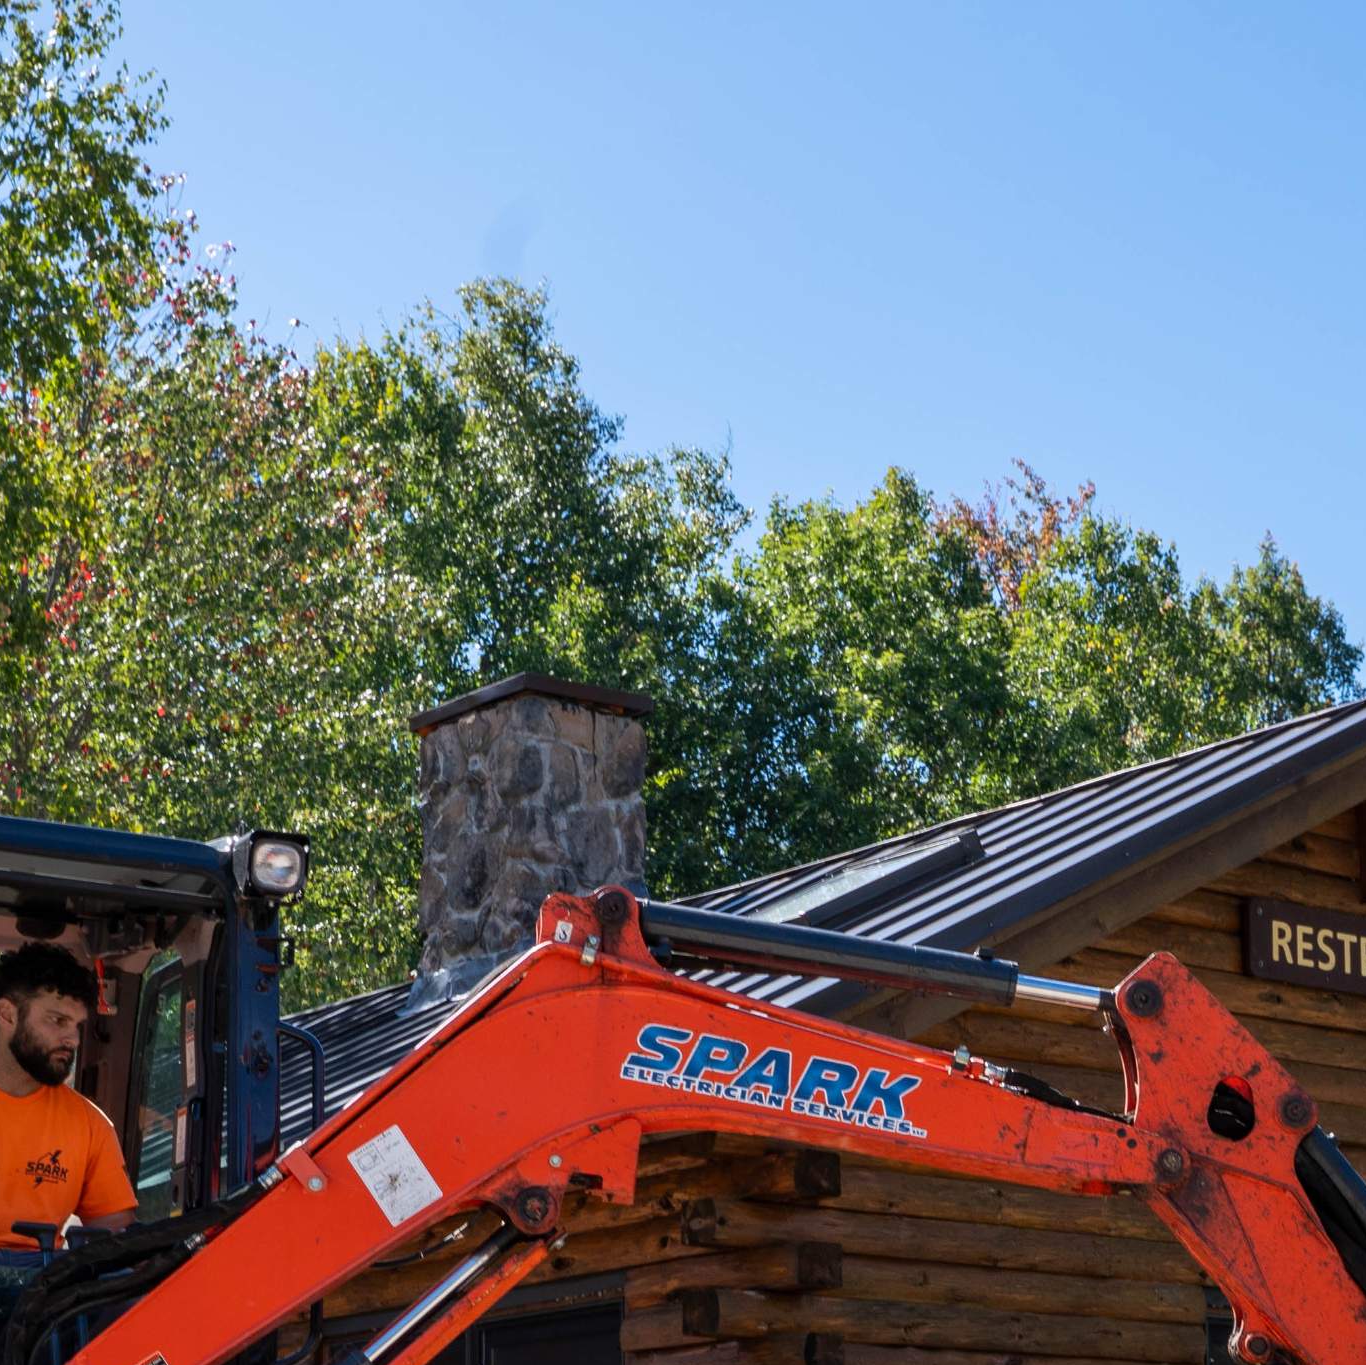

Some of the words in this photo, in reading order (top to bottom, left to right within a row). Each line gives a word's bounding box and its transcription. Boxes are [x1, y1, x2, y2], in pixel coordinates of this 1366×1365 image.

[621, 1066, 785, 1110] ELECTRICIAN
[791, 1101, 913, 1135] SERVICES
[627, 1023, 922, 1119] SPARK
[26, 1161, 68, 1179] SPARK
